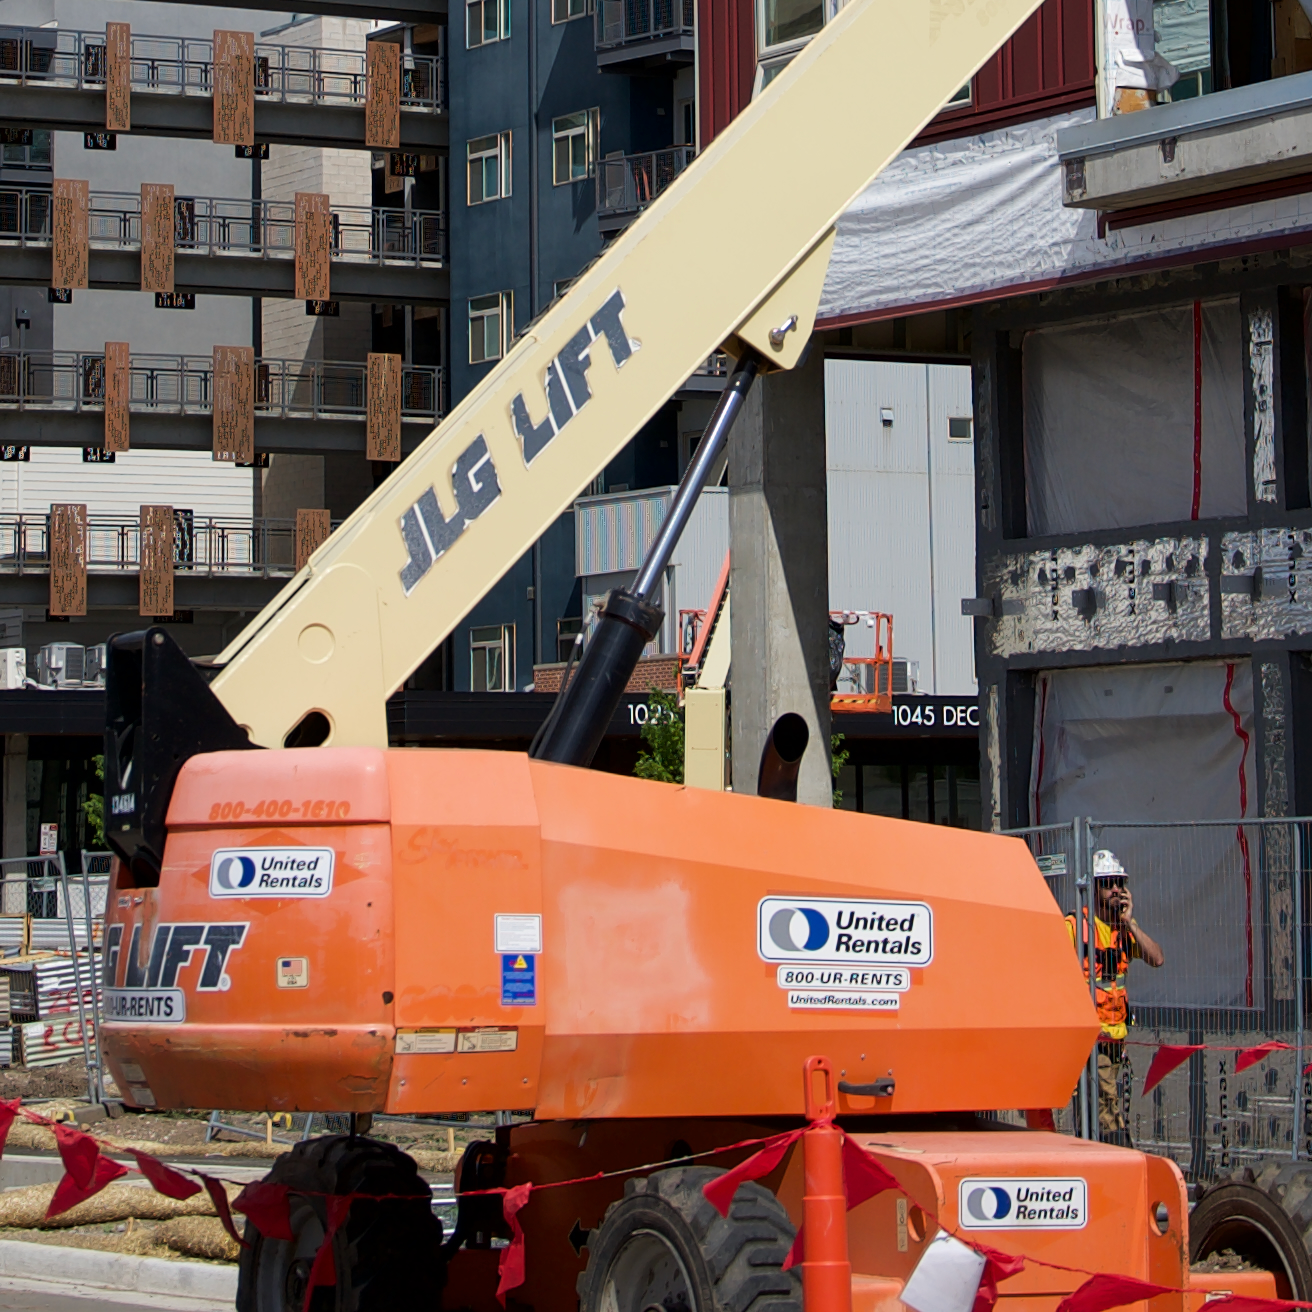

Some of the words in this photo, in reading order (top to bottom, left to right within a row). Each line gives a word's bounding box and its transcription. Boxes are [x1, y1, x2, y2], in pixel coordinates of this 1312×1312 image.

[399, 435, 502, 596] JLG
[510, 287, 634, 470] LIFT
[892, 704, 935, 727] 1045
[261, 855, 320, 872] United
[258, 872, 323, 889] Rentals
[835, 910, 916, 933] United
[835, 933, 923, 956] Rentals
[124, 921, 251, 991] LIFT
[784, 971, 904, 987] 800-UR-RENTS
[790, 994, 898, 1007] UnitedRentals.com
[1015, 1186, 1074, 1204] United
[1015, 1204, 1080, 1221] Rentals
